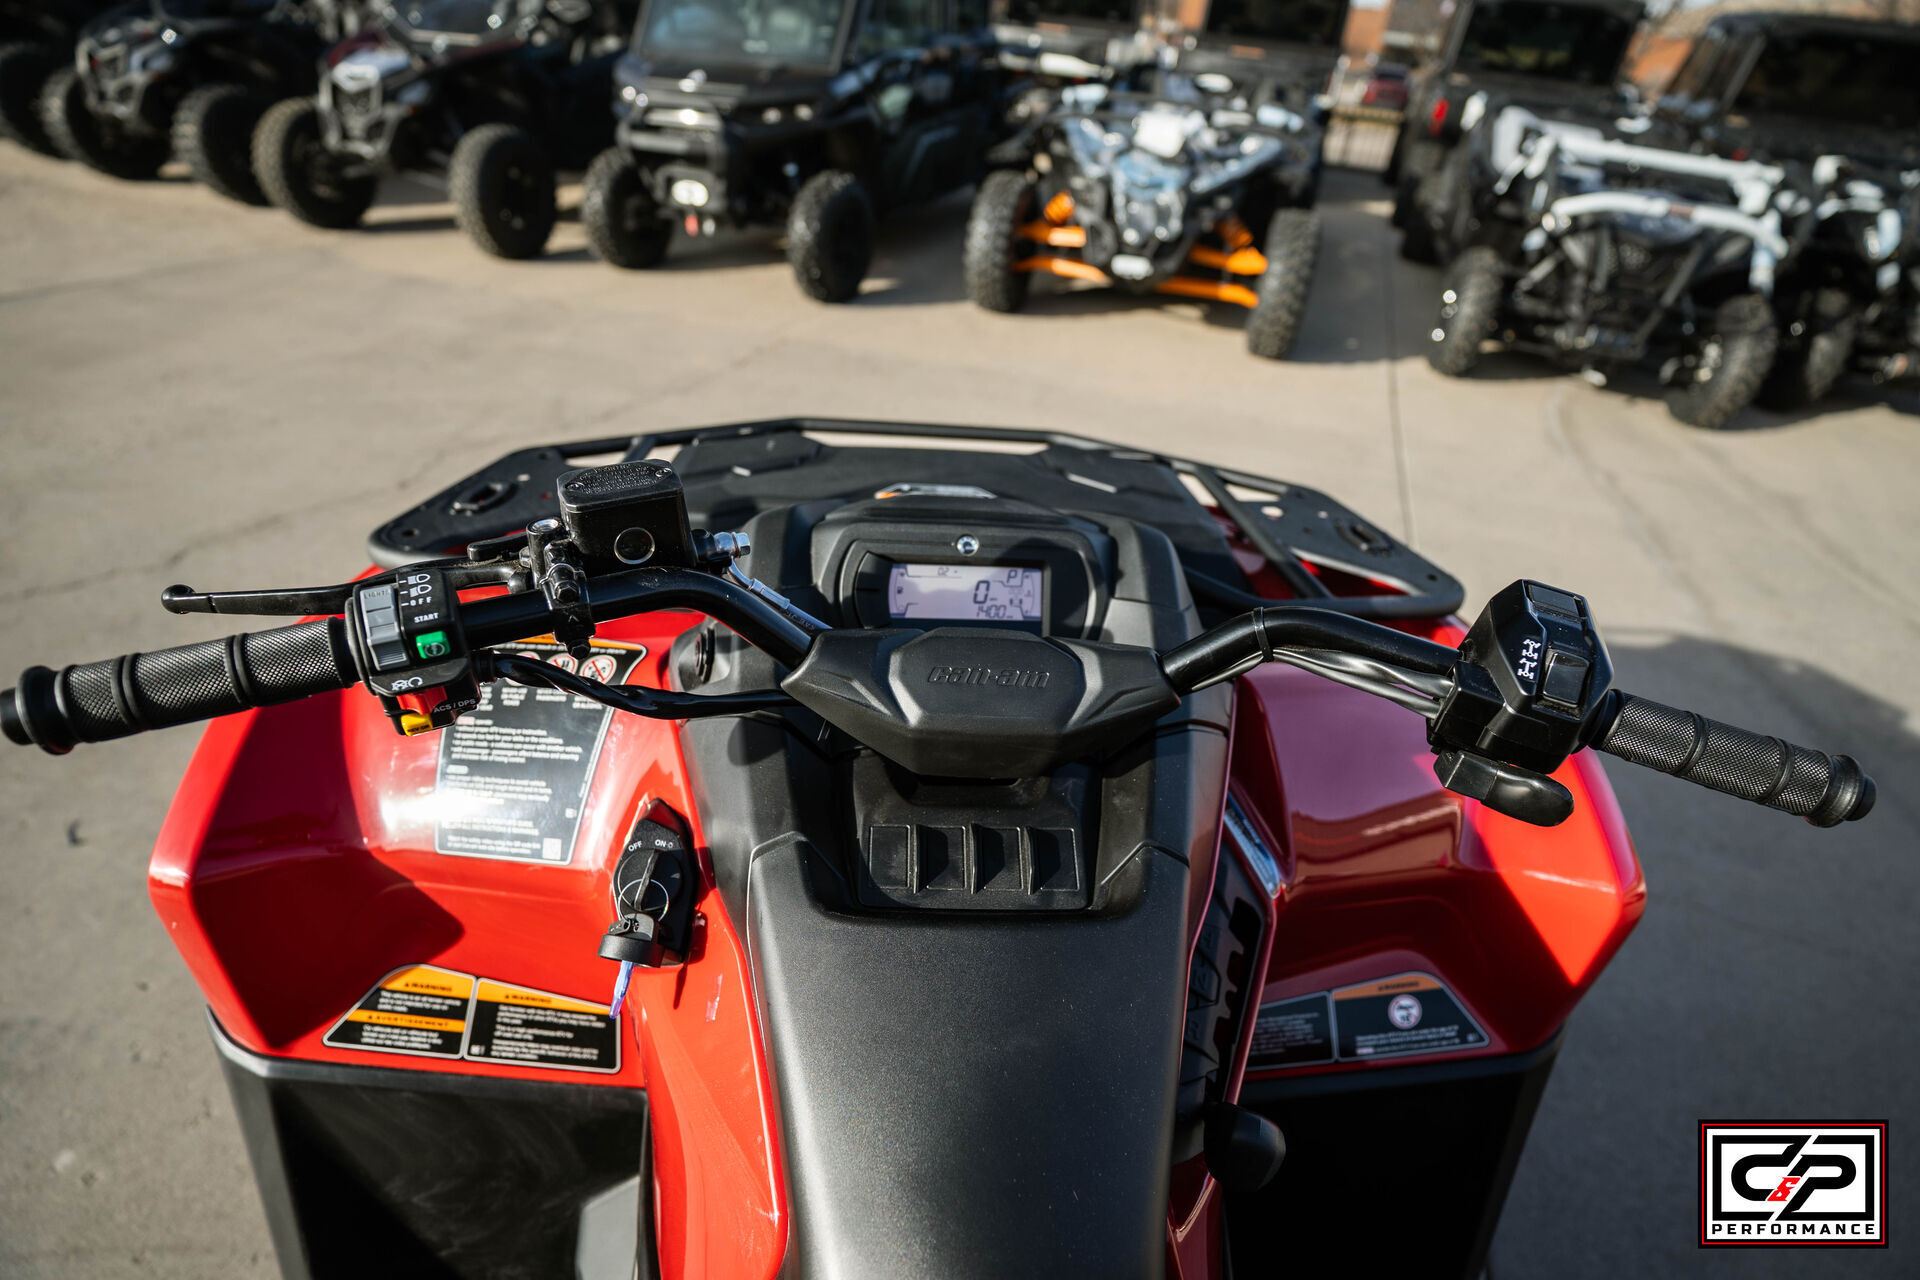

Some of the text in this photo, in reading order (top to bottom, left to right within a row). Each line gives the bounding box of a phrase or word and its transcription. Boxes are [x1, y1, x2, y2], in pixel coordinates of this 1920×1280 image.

[1007, 569, 1018, 583] P
[973, 580, 990, 604] 0
[410, 596, 432, 606] OFF
[414, 612, 439, 623] START
[976, 604, 1007, 619] 1400
[434, 703, 452, 713] ACS
[458, 699, 476, 708] DPS
[628, 841, 643, 852] OFF
